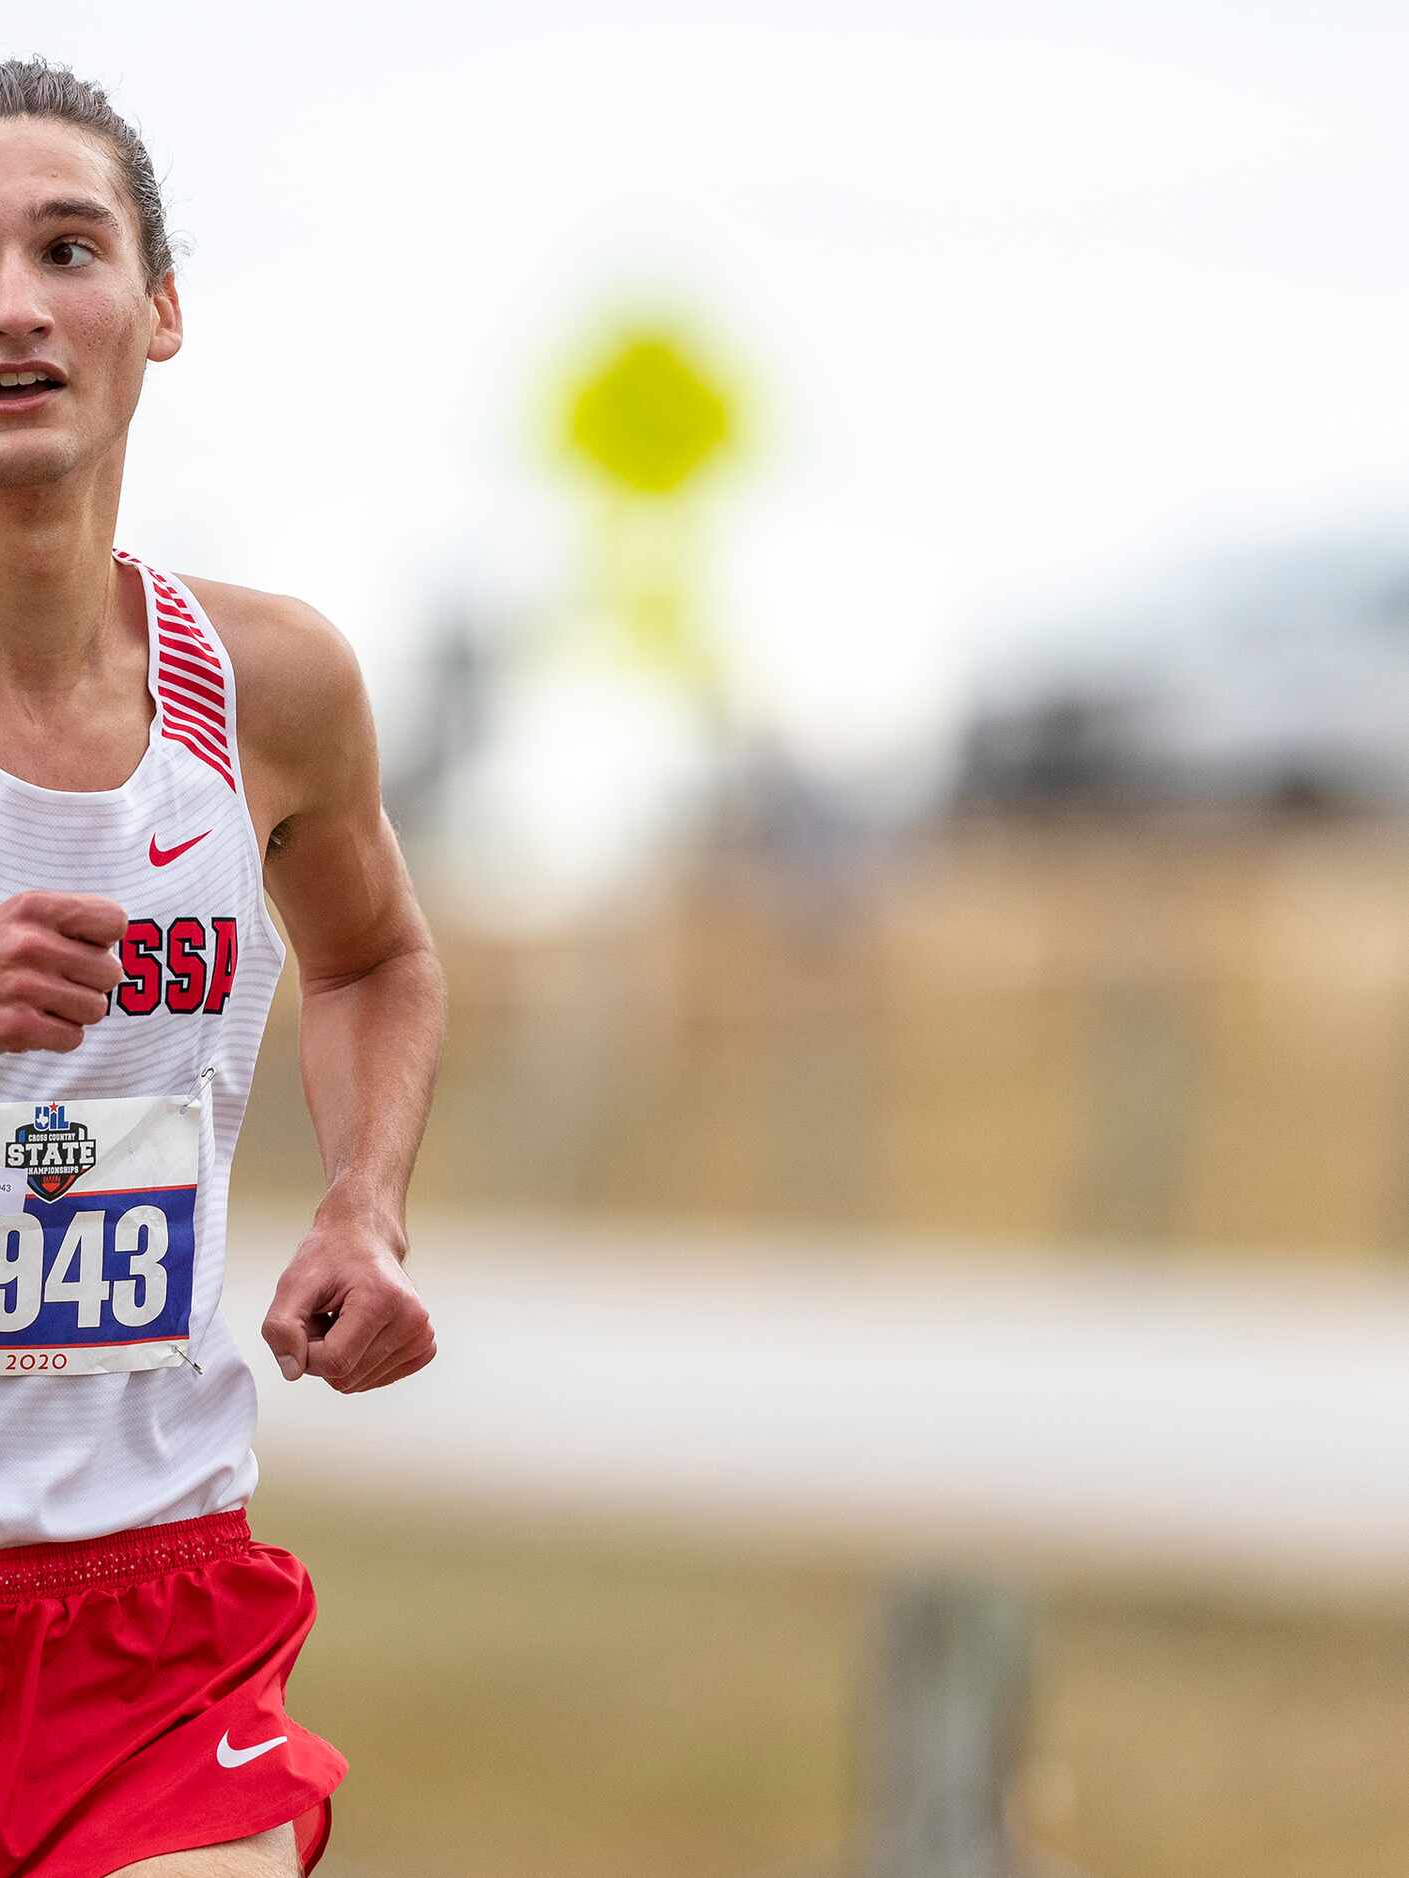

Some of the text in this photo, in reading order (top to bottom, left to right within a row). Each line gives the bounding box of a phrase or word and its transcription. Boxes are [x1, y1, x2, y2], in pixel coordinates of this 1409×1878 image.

[28, 1132, 76, 1142] CROSS COUNTRY
[7, 1141, 94, 1167] STATE
[28, 1166, 79, 1175] HAMPIONSHIPS
[5, 1353, 68, 1370] 2020
